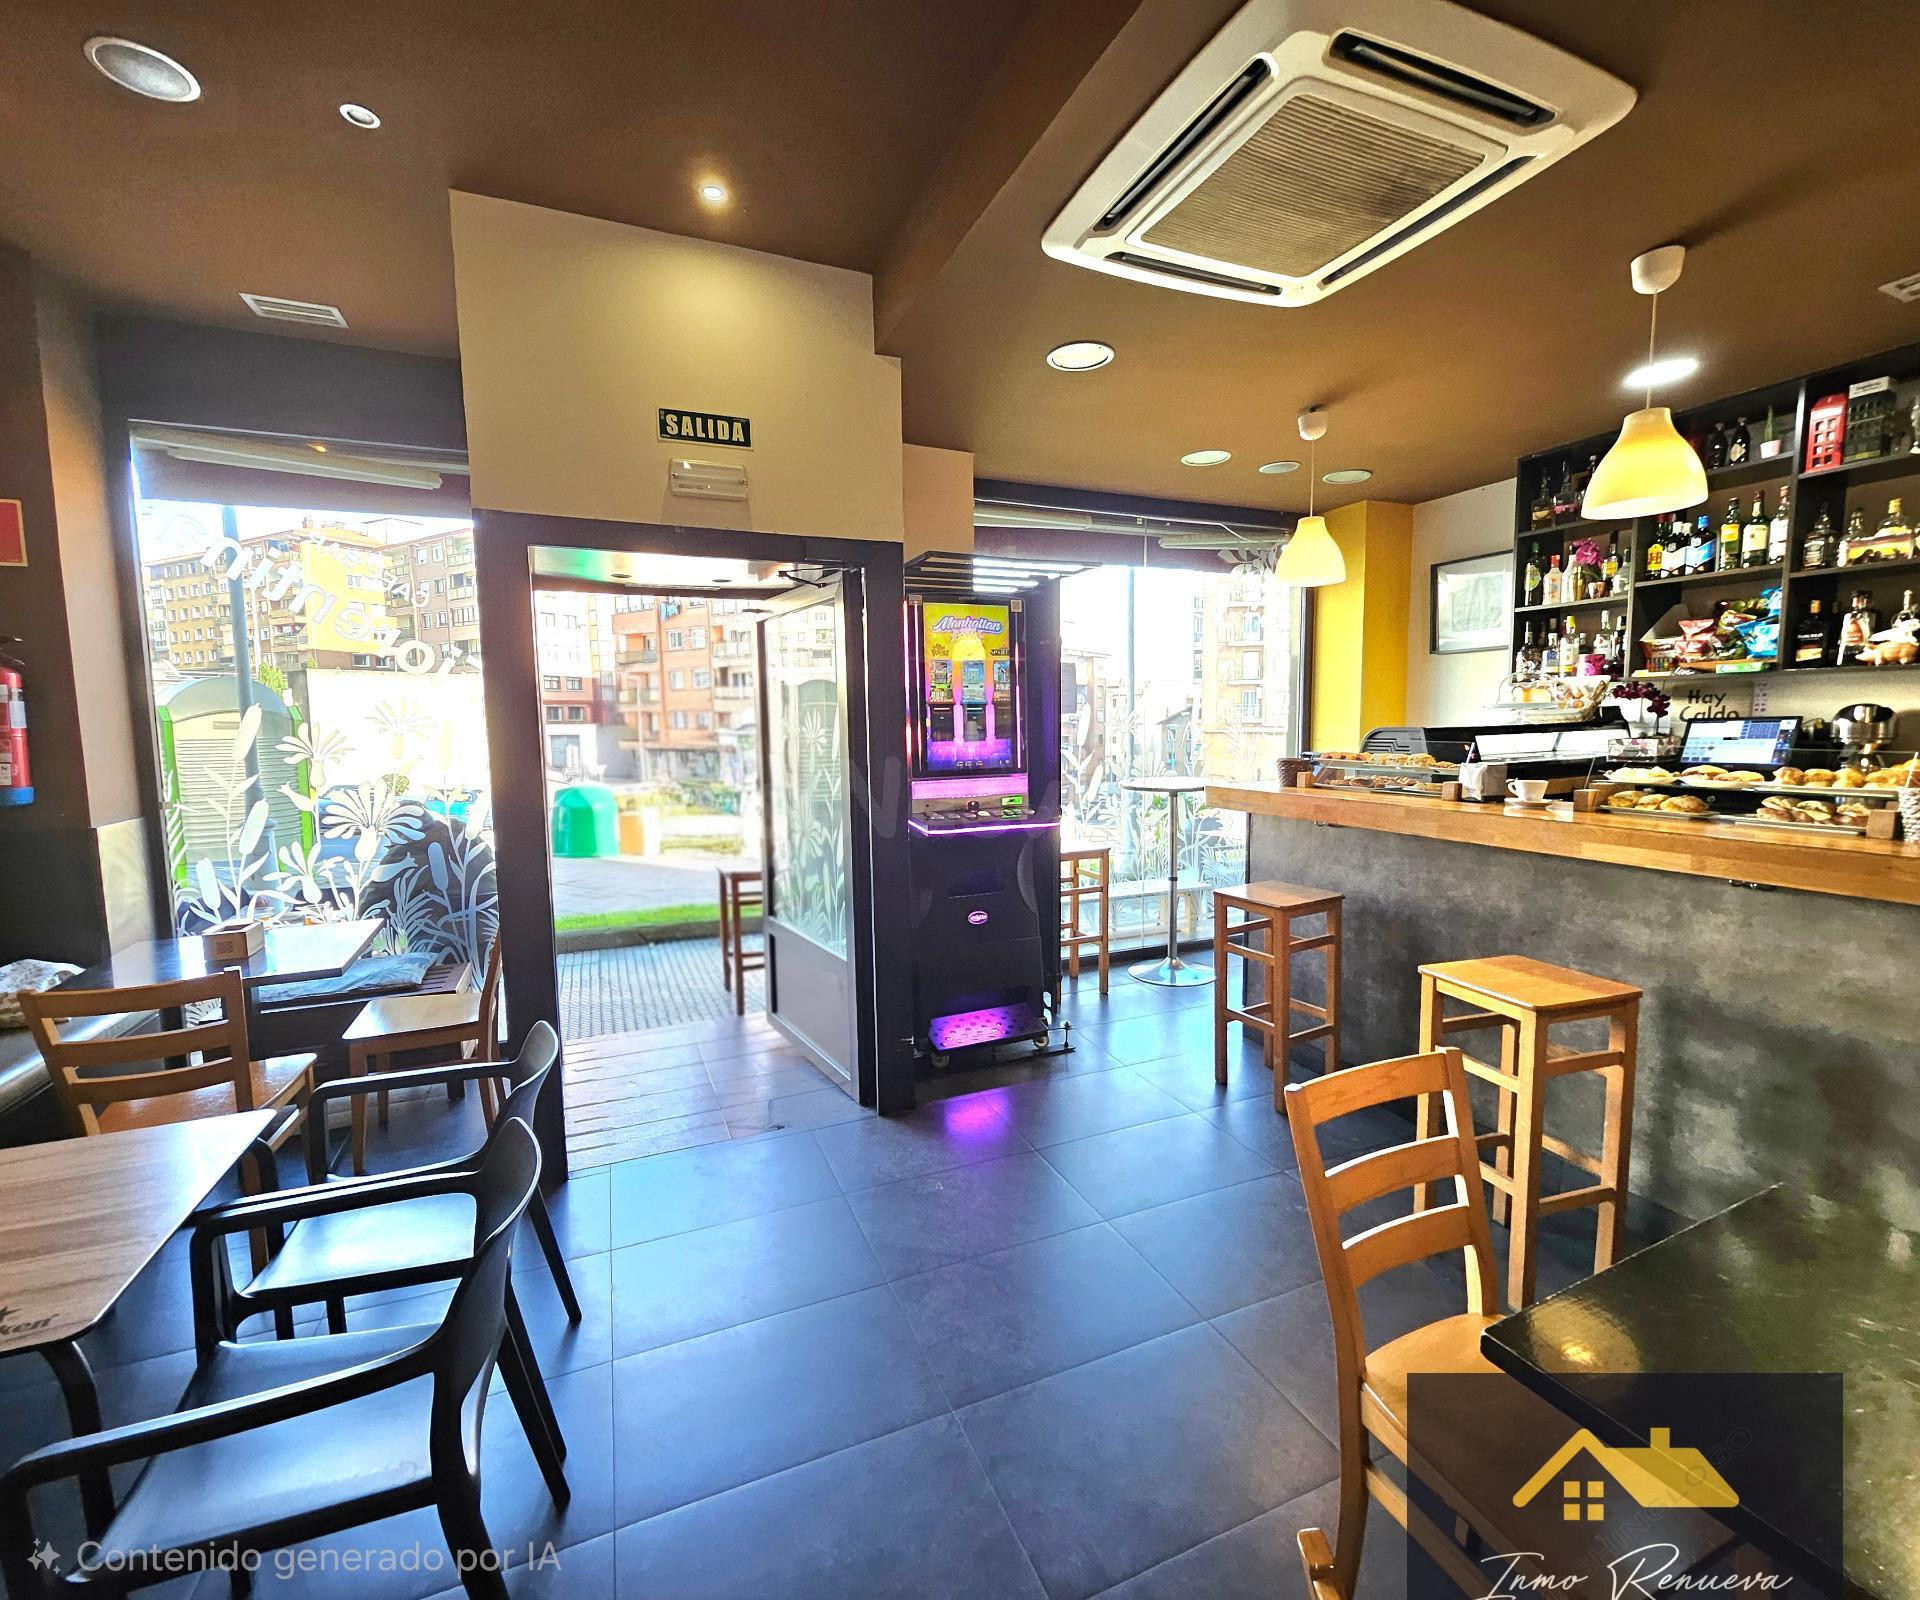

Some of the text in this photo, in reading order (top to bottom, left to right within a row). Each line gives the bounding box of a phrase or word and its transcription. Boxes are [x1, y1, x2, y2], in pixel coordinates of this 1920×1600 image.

[665, 413, 745, 442] SALIDA
[932, 615, 1003, 634] Manhattan
[1687, 689, 1727, 706] Hay
